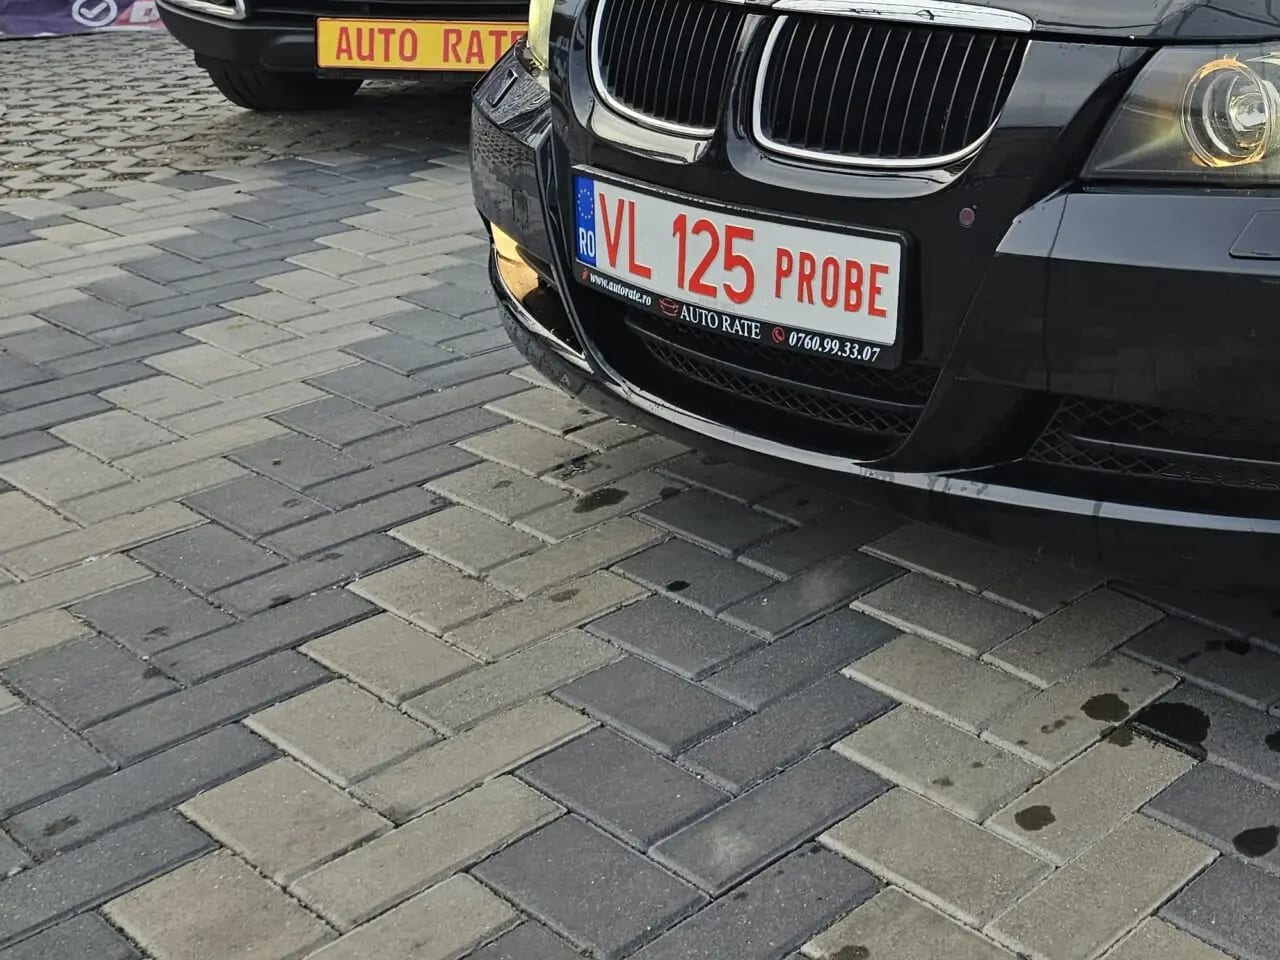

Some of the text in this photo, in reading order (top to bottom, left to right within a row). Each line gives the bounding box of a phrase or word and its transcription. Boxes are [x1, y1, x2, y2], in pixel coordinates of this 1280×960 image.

[335, 26, 529, 65] AUTO RAT
[579, 227, 595, 258] RO
[598, 191, 890, 319] VL 125 PROBE
[589, 273, 652, 307] www.autorate.ro
[679, 304, 762, 340] AUTO RATE
[788, 331, 881, 362] 0760.99.33.07
